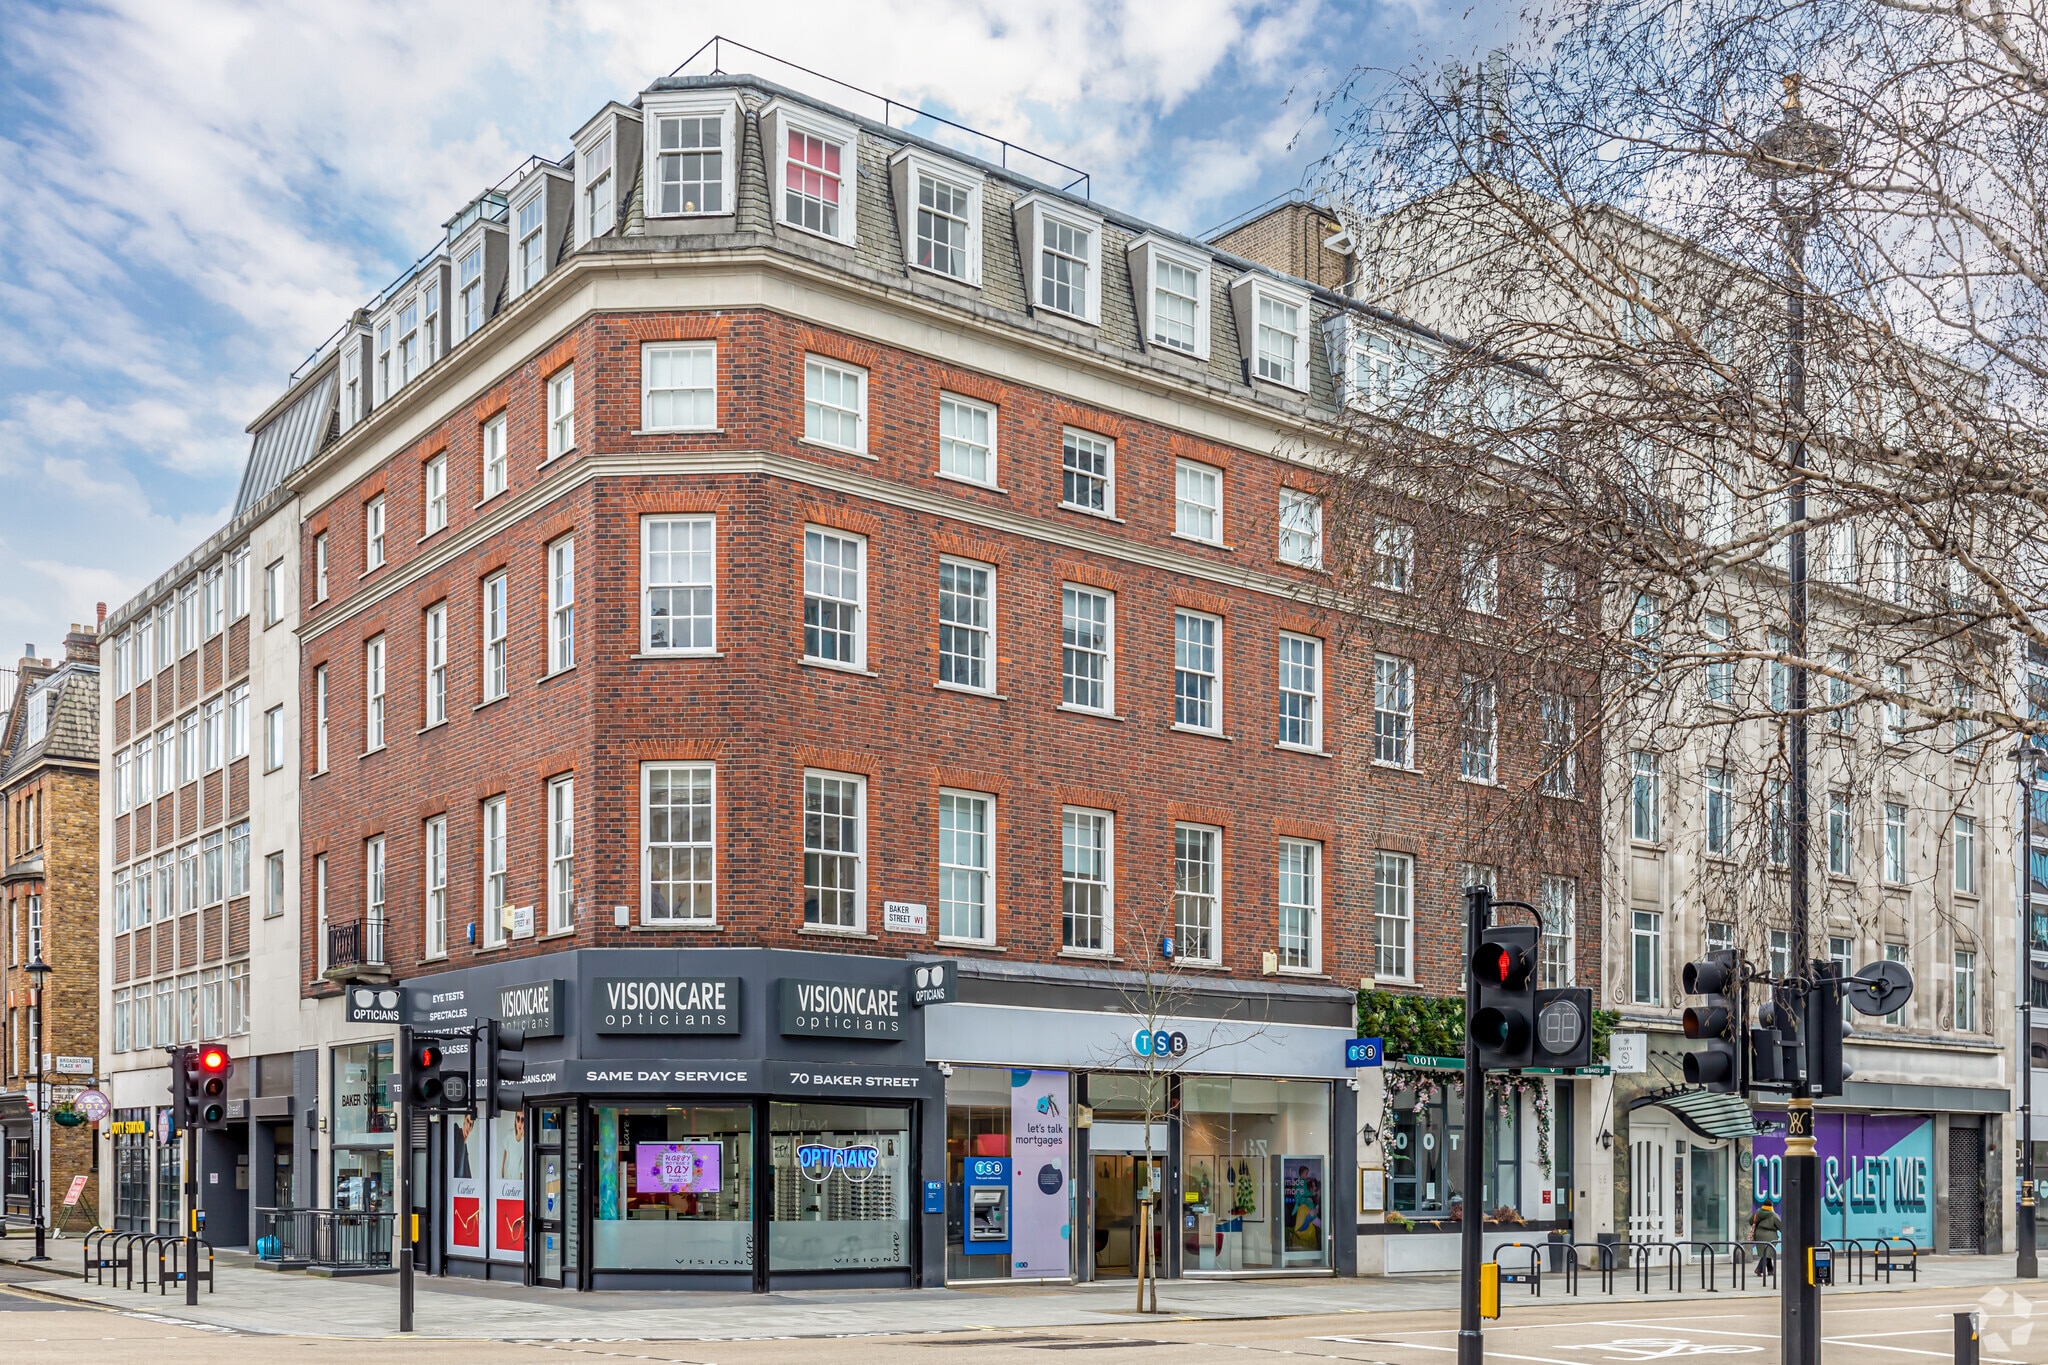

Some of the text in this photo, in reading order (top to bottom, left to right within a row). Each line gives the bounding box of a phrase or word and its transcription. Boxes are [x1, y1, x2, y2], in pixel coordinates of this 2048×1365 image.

[889, 904, 910, 914] BAKER
[888, 913, 923, 925] STREET W1
[432, 990, 465, 1004] EYE TESTS
[607, 982, 726, 1010] VISIONCARE
[797, 984, 899, 1017] VISIONCARE
[915, 988, 945, 1002] OPTICIANS
[501, 986, 549, 1018] VISIONCARE
[353, 1009, 400, 1021] OPTICIANS
[429, 1008, 468, 1021] SPECTACLES
[605, 1012, 726, 1028] opticians
[796, 1015, 899, 1032] opticians
[439, 1044, 469, 1056] GLASSES
[1138, 1033, 1185, 1054] TSB
[1349, 1046, 1375, 1059] TSB
[1413, 1055, 1438, 1066] OOTY
[360, 1069, 367, 1081] 70
[586, 1071, 748, 1082] SAME DAY SERVICE
[790, 1072, 919, 1087] 70 BAKER STREET
[342, 1094, 361, 1106] BAKER
[112, 1121, 145, 1135] OOTY STATION
[1027, 1123, 1063, 1134] let's talk
[1015, 1136, 1063, 1147] mortgages
[665, 1154, 691, 1162] HAPPY
[800, 1148, 877, 1168] OPTICIANS
[665, 1165, 689, 1175] DAY
[976, 1162, 1002, 1174] TSB
[1284, 1178, 1305, 1186] made
[1824, 1155, 1844, 1206] &
[1851, 1155, 1891, 1206] LET
[1894, 1155, 1926, 1206] ME
[457, 1182, 476, 1195] Cartier
[501, 1183, 522, 1197] Cartier
[1284, 1187, 1305, 1195] more
